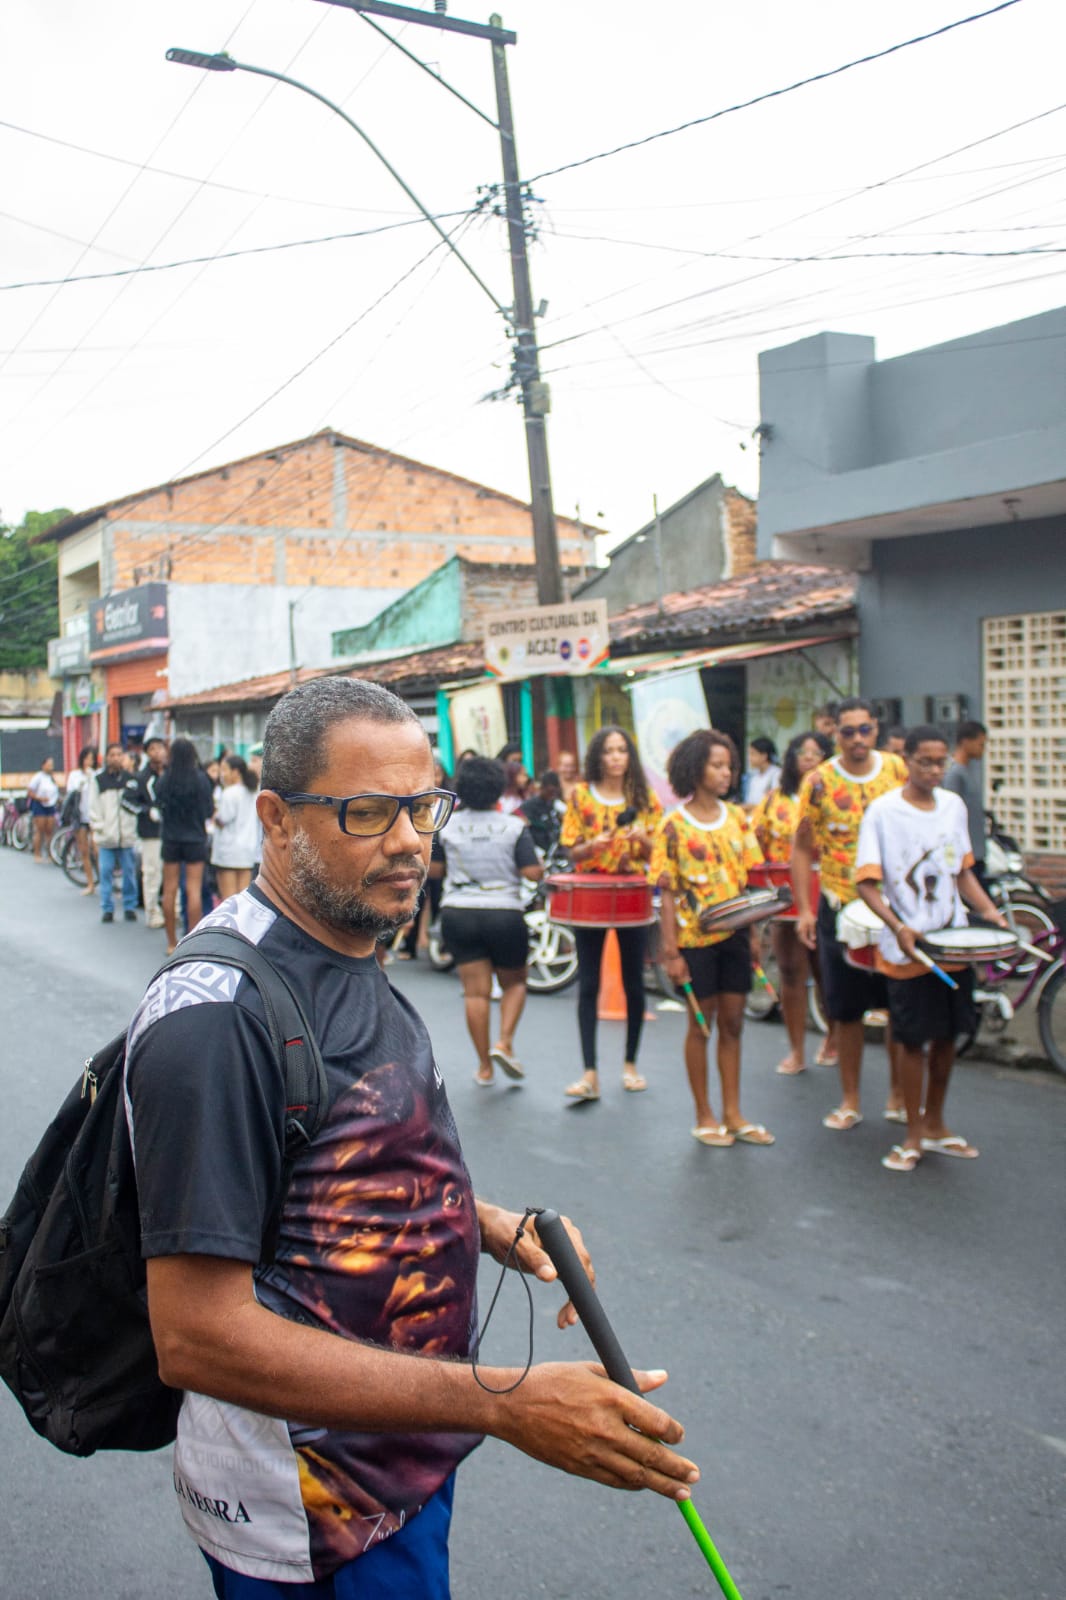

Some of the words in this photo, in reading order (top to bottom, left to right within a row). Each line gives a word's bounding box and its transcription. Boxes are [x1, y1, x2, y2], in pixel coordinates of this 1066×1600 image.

[488, 619, 526, 636] CENTRO
[529, 614, 580, 632] CULTURAL
[583, 610, 599, 626] DA
[527, 638, 557, 656] ACAZ
[185, 1483, 252, 1523] NEGRA
